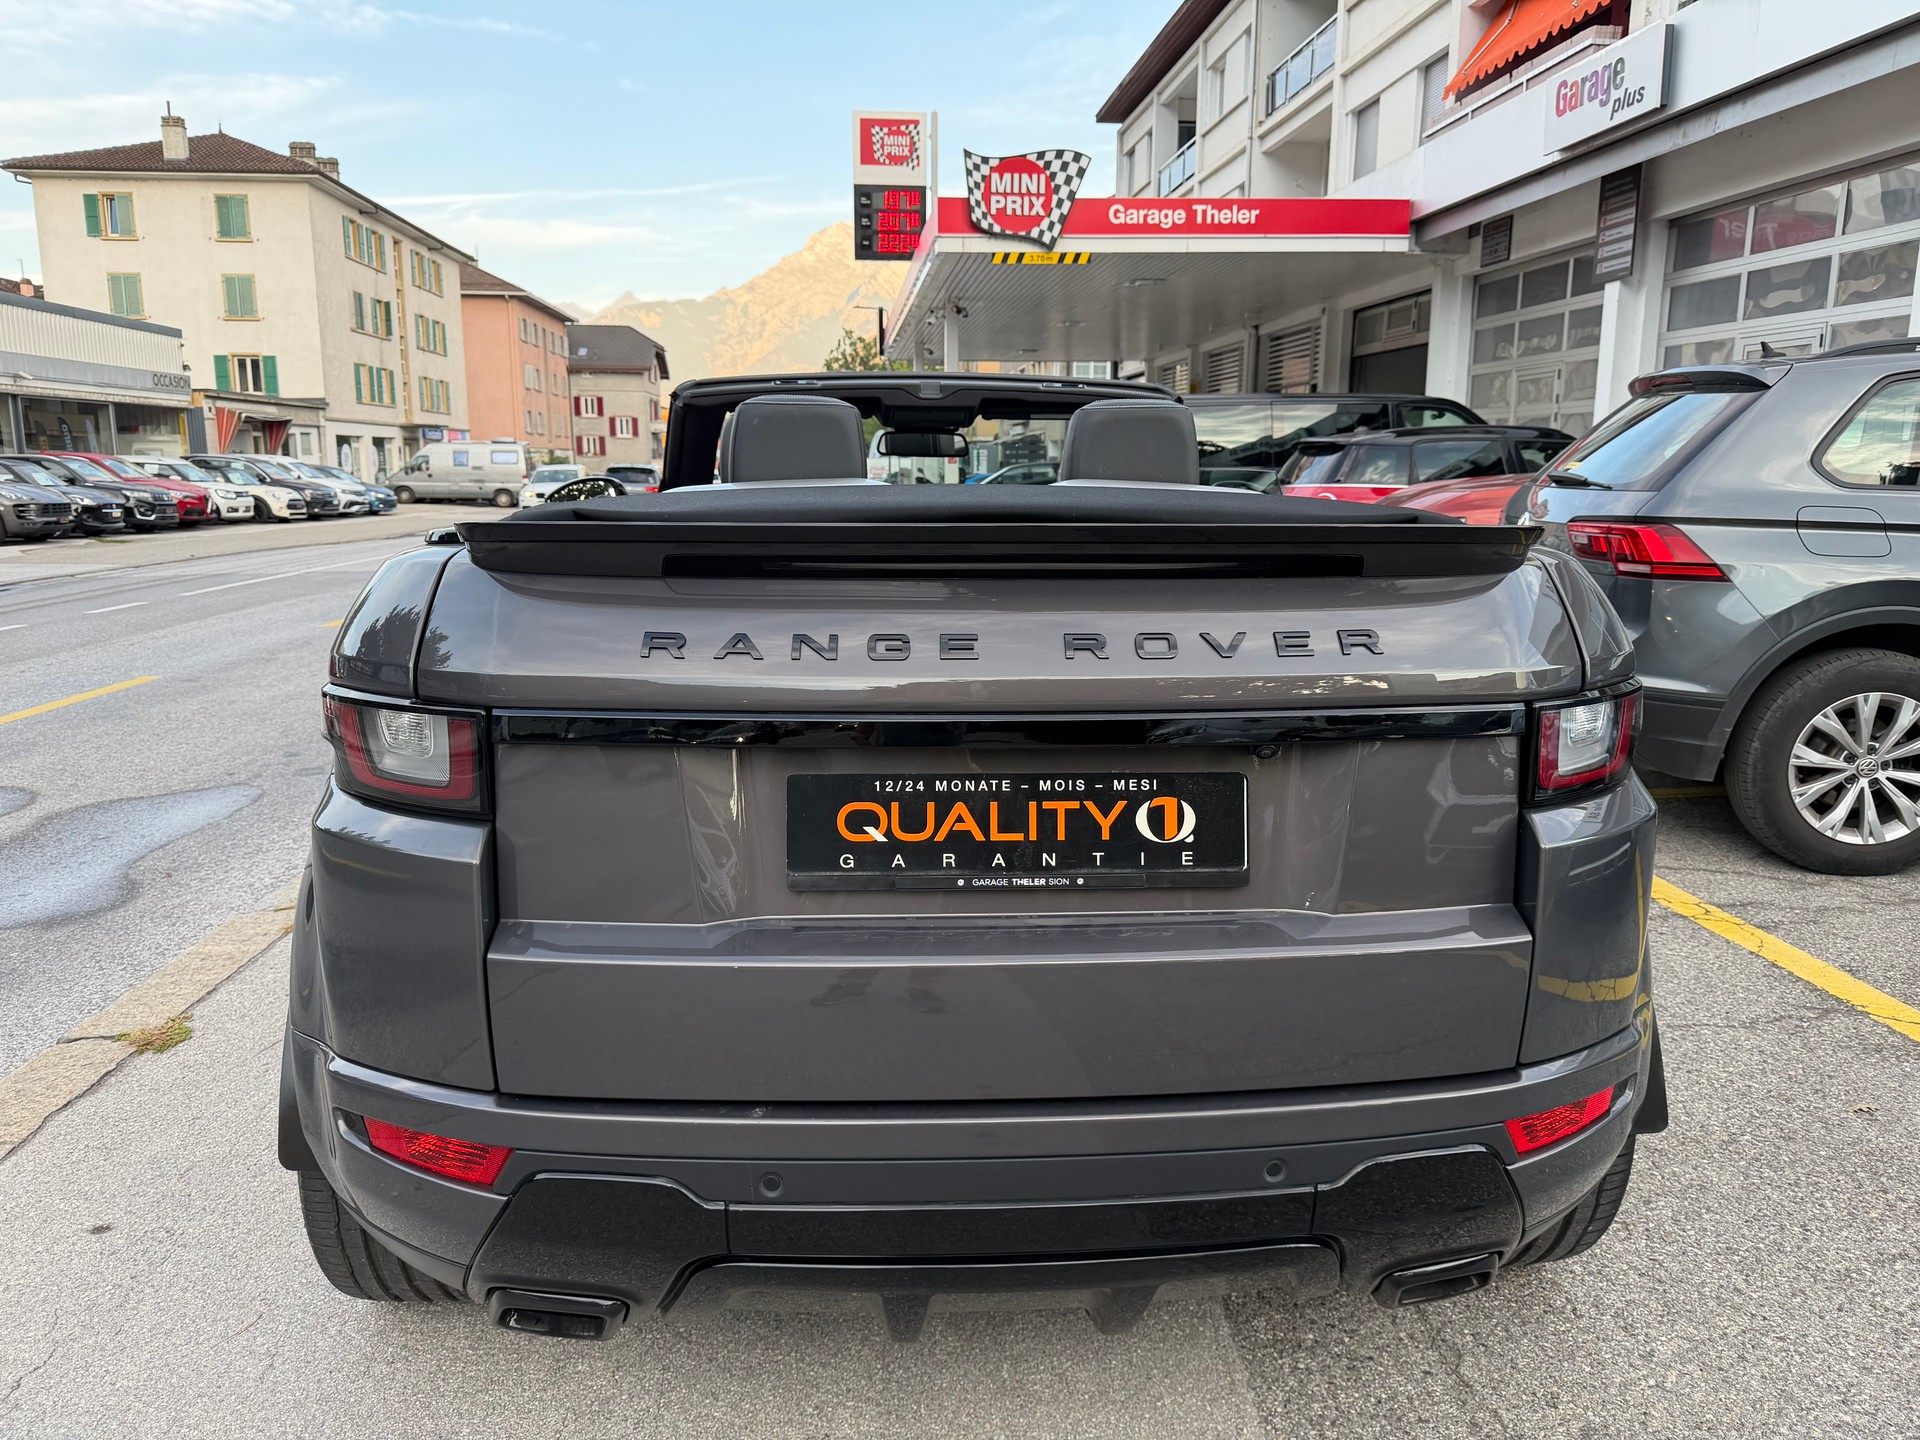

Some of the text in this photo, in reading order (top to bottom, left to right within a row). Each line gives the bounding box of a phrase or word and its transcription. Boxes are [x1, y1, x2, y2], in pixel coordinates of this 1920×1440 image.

[1555, 57, 1625, 118] Garage
[1610, 86, 1645, 121] plus
[883, 134, 910, 146] MINI
[883, 146, 911, 157] PRIX
[990, 172, 1046, 194] MINI
[990, 195, 1046, 216] PRIX
[1108, 203, 1261, 229] Garage Theler
[640, 629, 1385, 662] RANGE ROVER
[873, 779, 926, 792] 12/24
[935, 779, 1012, 791] MONATE
[1039, 779, 1086, 791] MOIS
[1113, 778, 1158, 791] MESI
[836, 801, 1128, 843] QUALITY
[839, 851, 1195, 869] GARANTIE
[972, 877, 1070, 886] GARAGE THELER SION
